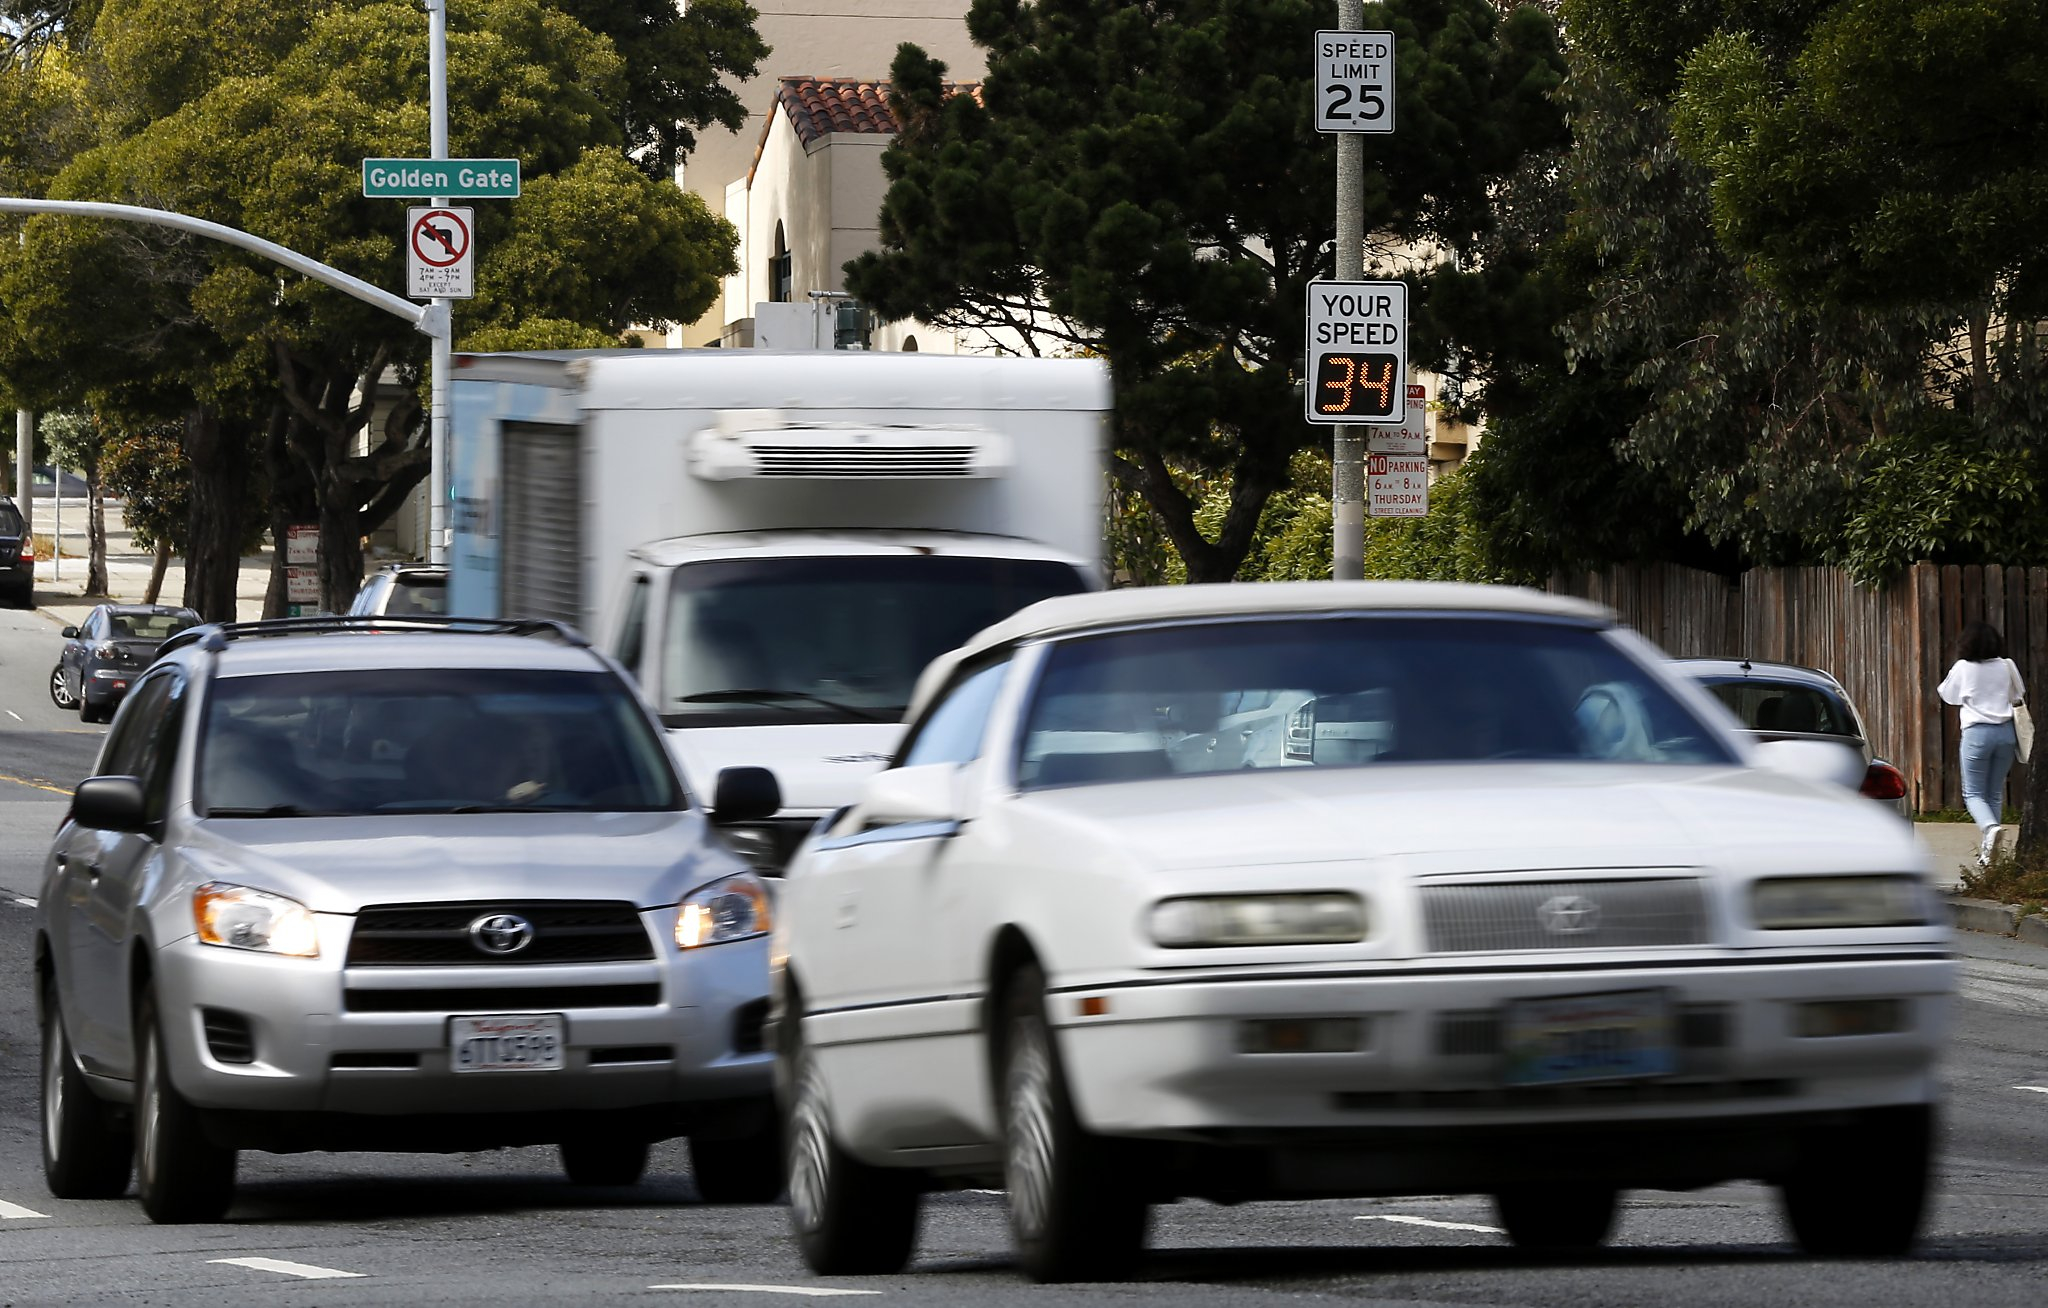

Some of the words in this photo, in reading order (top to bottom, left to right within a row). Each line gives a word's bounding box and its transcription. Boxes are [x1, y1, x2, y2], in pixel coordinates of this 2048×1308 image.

[1322, 43, 1387, 59] SPEED
[1331, 64, 1380, 79] LIMIT
[1325, 84, 1385, 120] 25
[370, 168, 449, 188] Golden
[458, 168, 513, 188] Gate
[419, 267, 435, 275] 7AM
[444, 267, 460, 275] 9AM
[445, 274, 460, 282] 7PM
[1321, 294, 1392, 318] YOUR
[1316, 322, 1398, 345] SPEED
[1322, 357, 1393, 412] 34
[1370, 457, 1386, 473] NO
[1388, 461, 1425, 473] PARKING
[1375, 478, 1381, 490] 6
[1403, 477, 1410, 490] 8
[1374, 494, 1422, 504] THURSDAY
[1395, 507, 1423, 515] CLEANING
